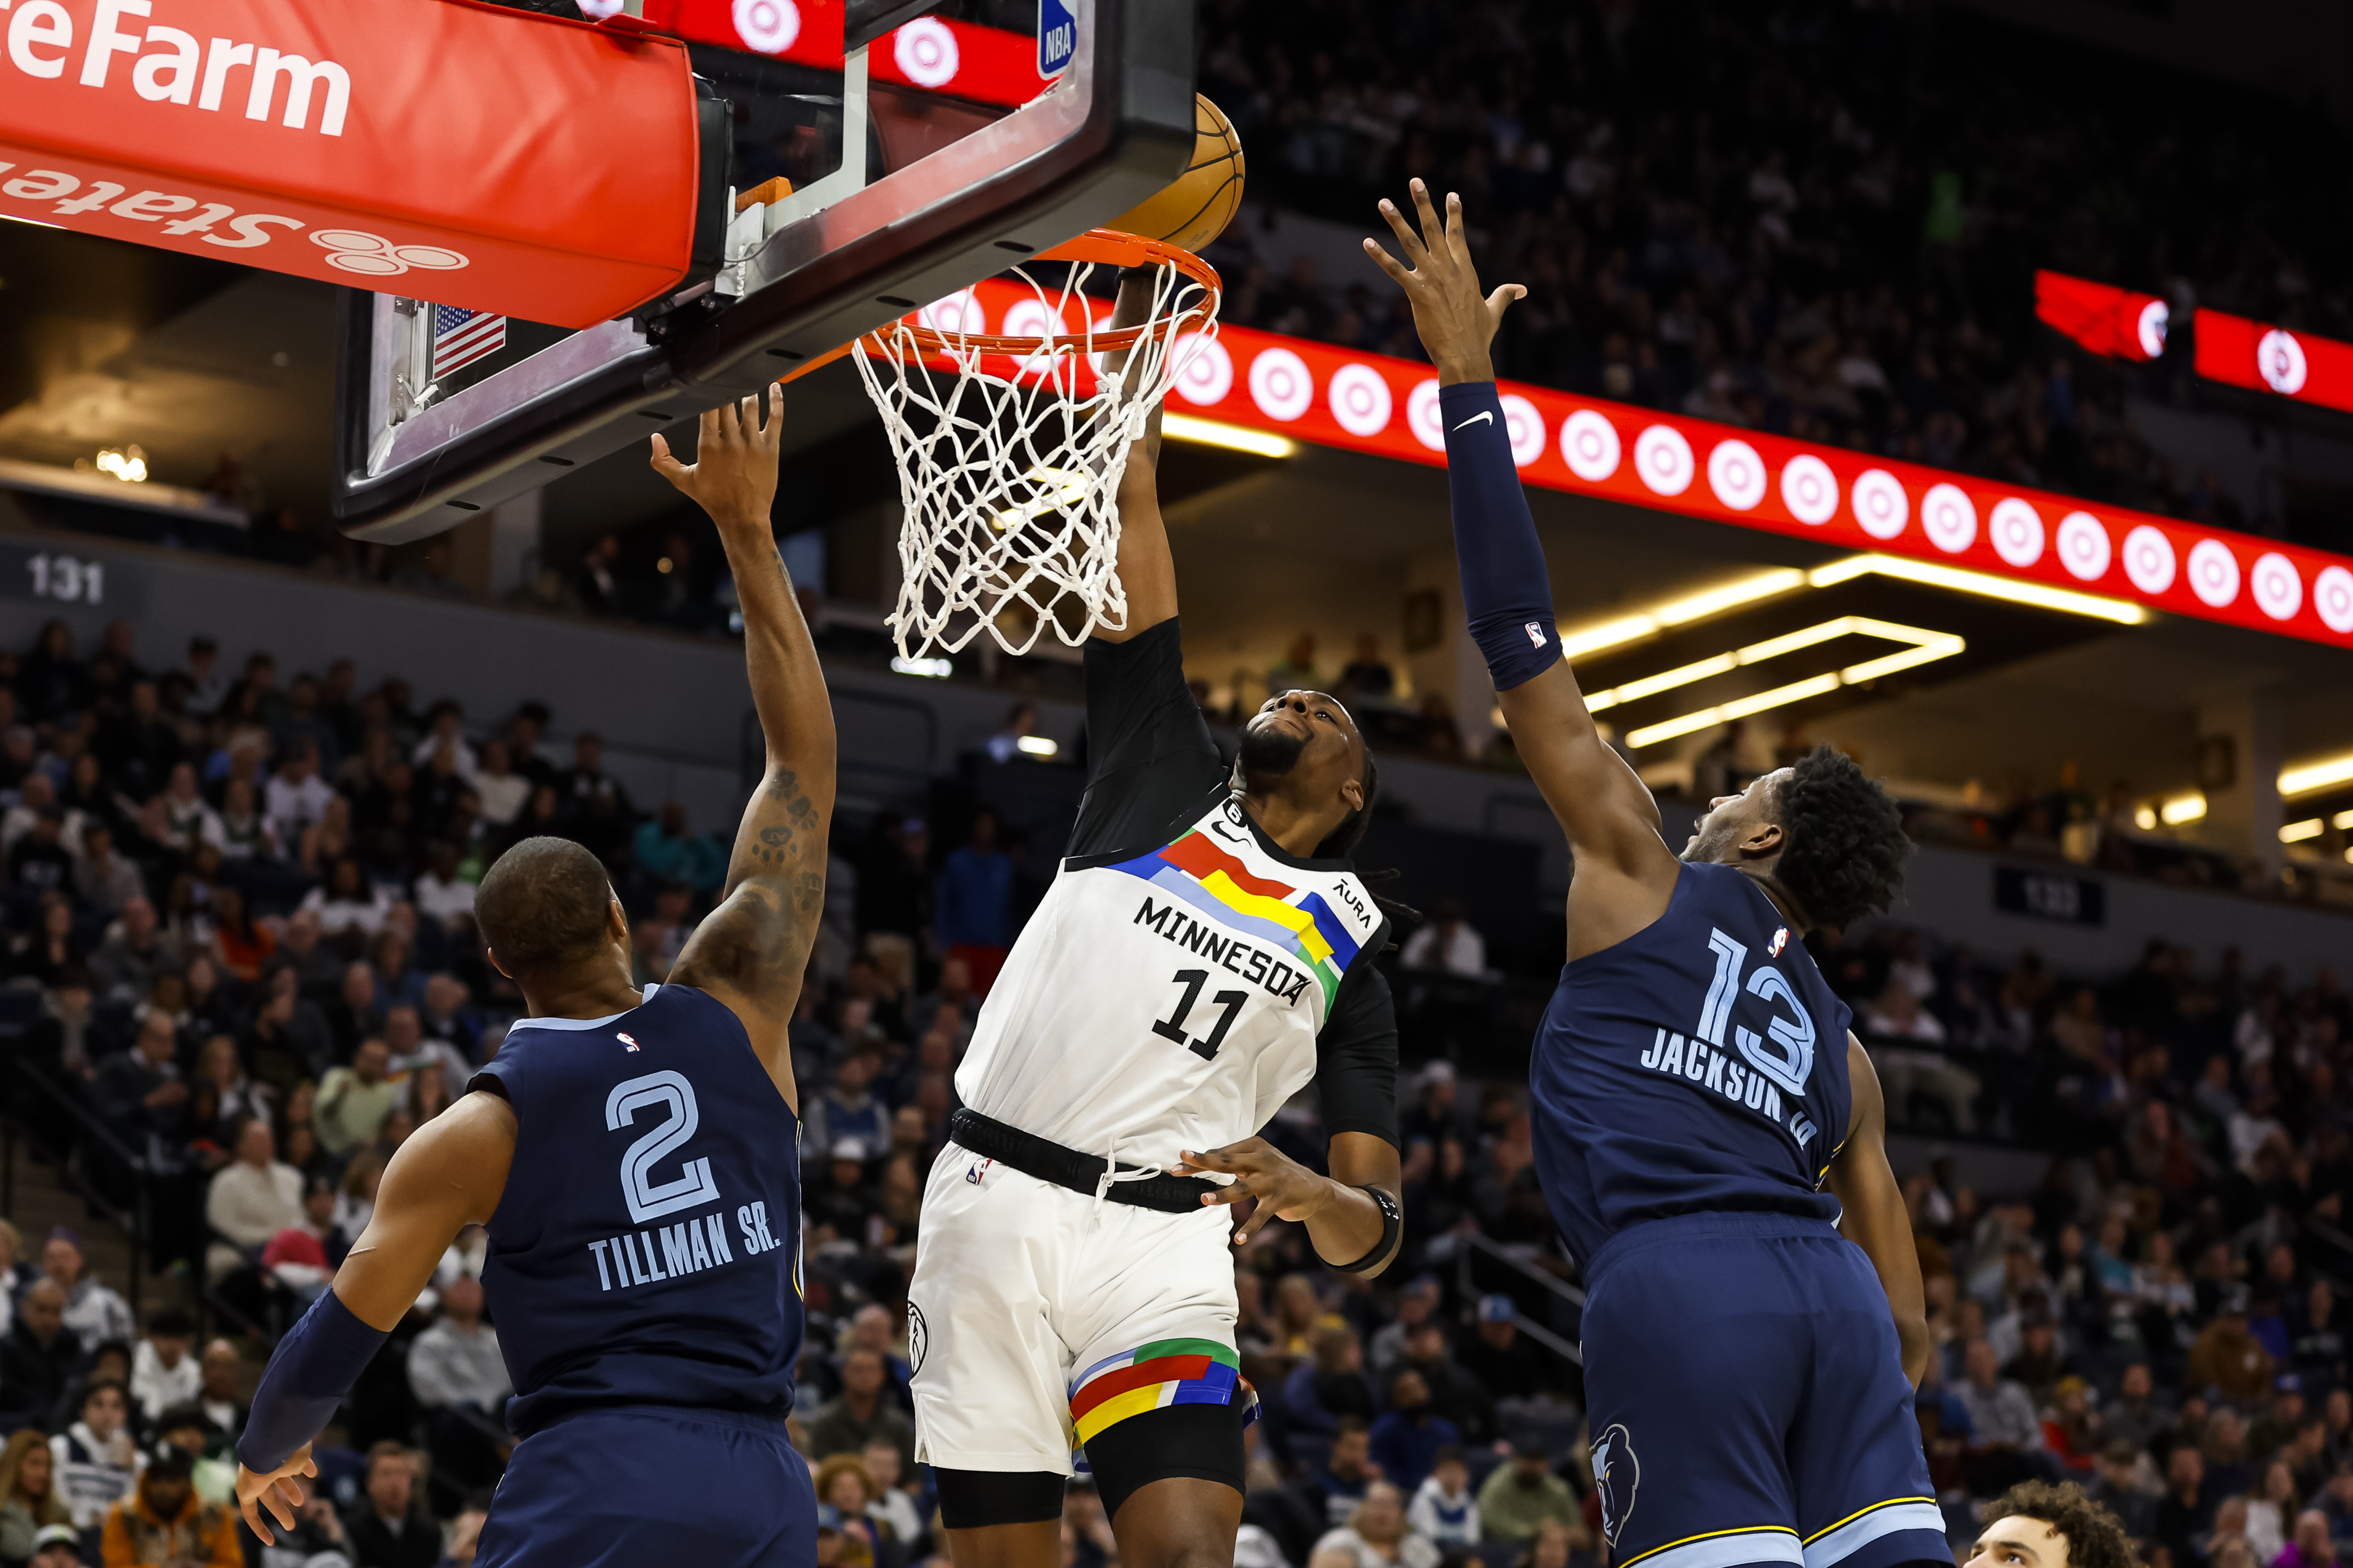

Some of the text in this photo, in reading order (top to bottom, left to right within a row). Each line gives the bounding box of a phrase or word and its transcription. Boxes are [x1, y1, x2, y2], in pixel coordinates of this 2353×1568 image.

[1045, 22, 1072, 65] NBA
[28, 553, 103, 604] 131
[1227, 803, 1242, 824] 6
[1152, 970, 1249, 1061] 11
[1697, 927, 1816, 1096] 13
[1641, 1027, 1782, 1122] JACKSON
[606, 1070, 720, 1224] 2
[588, 1201, 781, 1291] TILLMAN SR.
